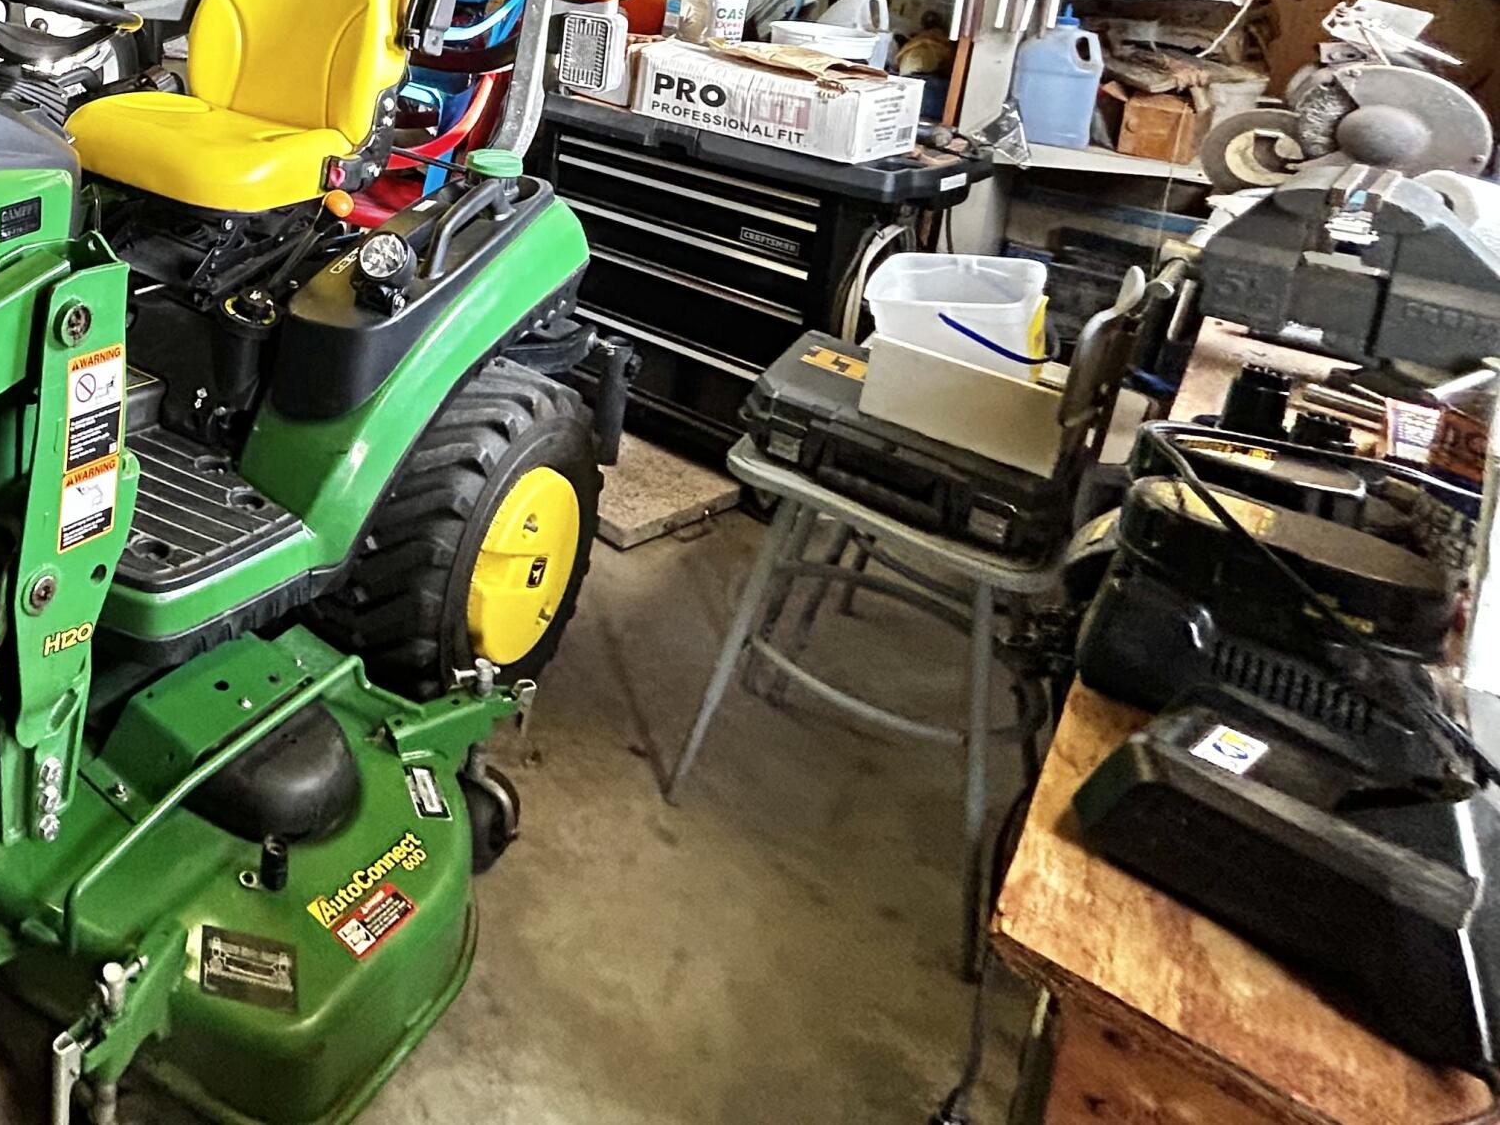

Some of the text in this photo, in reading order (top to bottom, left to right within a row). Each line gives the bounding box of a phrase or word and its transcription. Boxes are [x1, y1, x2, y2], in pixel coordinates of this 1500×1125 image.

[653, 73, 726, 107] PRO
[651, 101, 805, 144] PROFESSIONAL FIT
[79, 347, 121, 368] WARNING
[74, 460, 116, 484] WARNING
[43, 622, 93, 657] H120
[401, 848, 427, 871] 60D
[318, 831, 423, 923] AutoConnect
